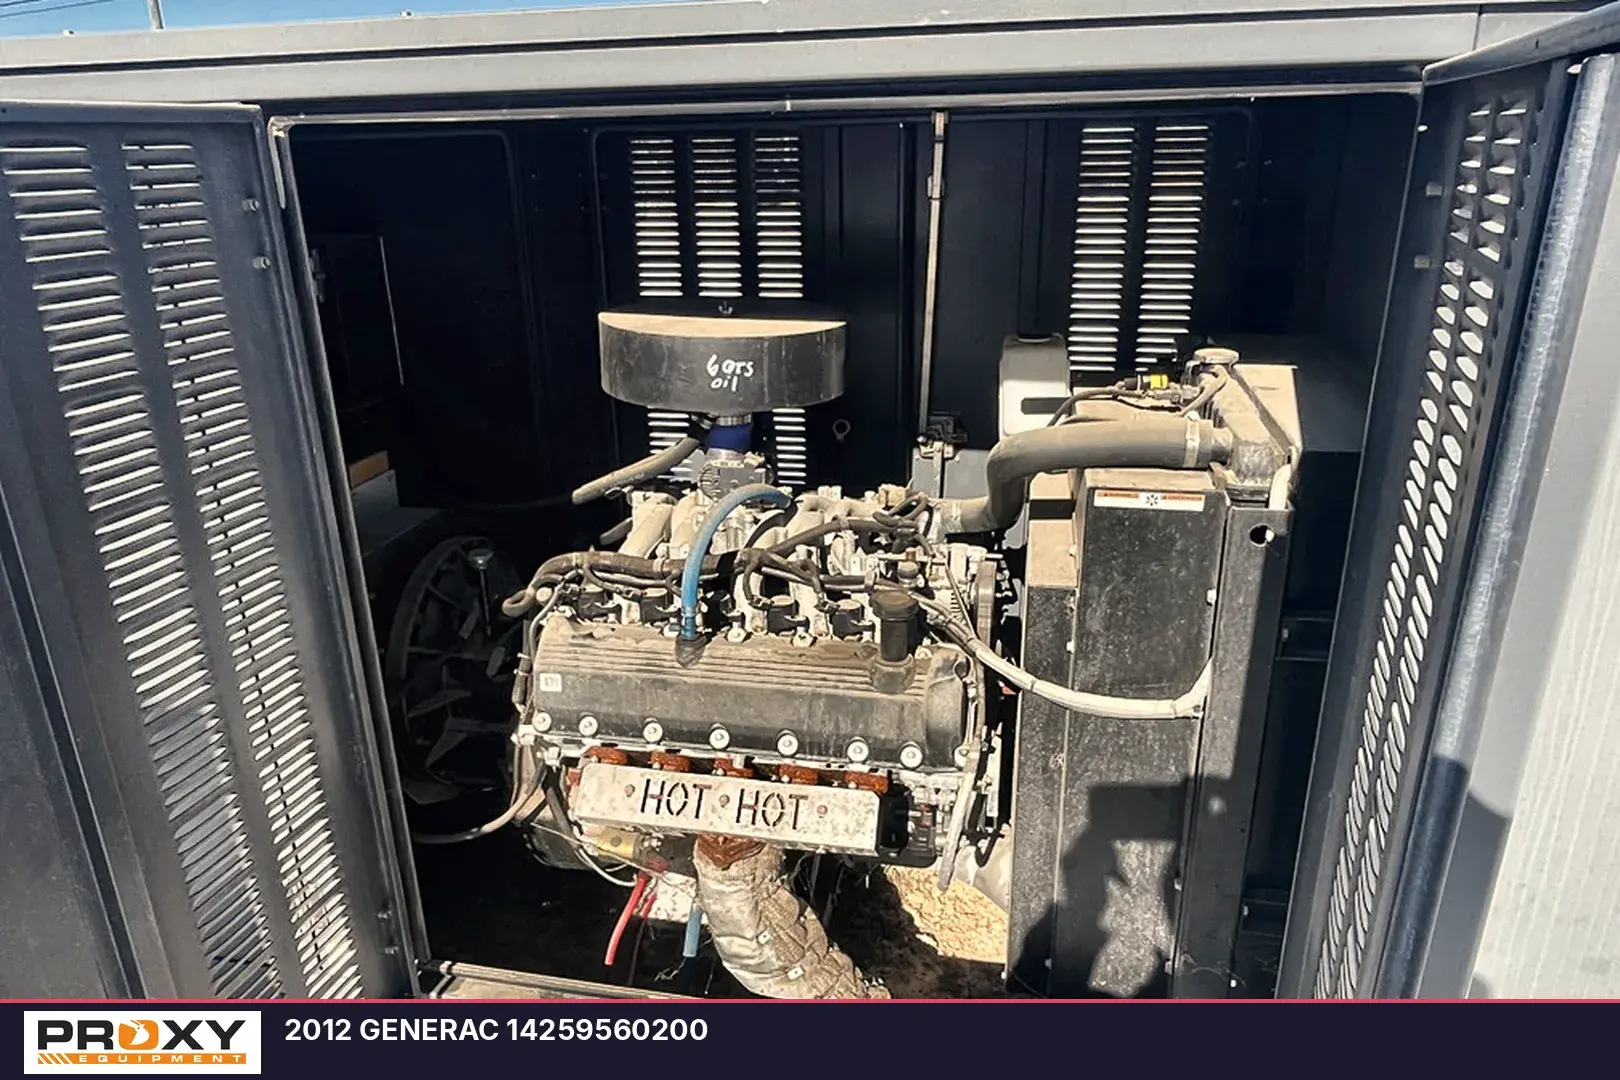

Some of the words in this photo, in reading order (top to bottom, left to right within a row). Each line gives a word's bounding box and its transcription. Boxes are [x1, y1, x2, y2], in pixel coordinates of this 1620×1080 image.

[706, 354, 719, 377] 6
[640, 778, 713, 819] HOT
[735, 788, 809, 830] HOT
